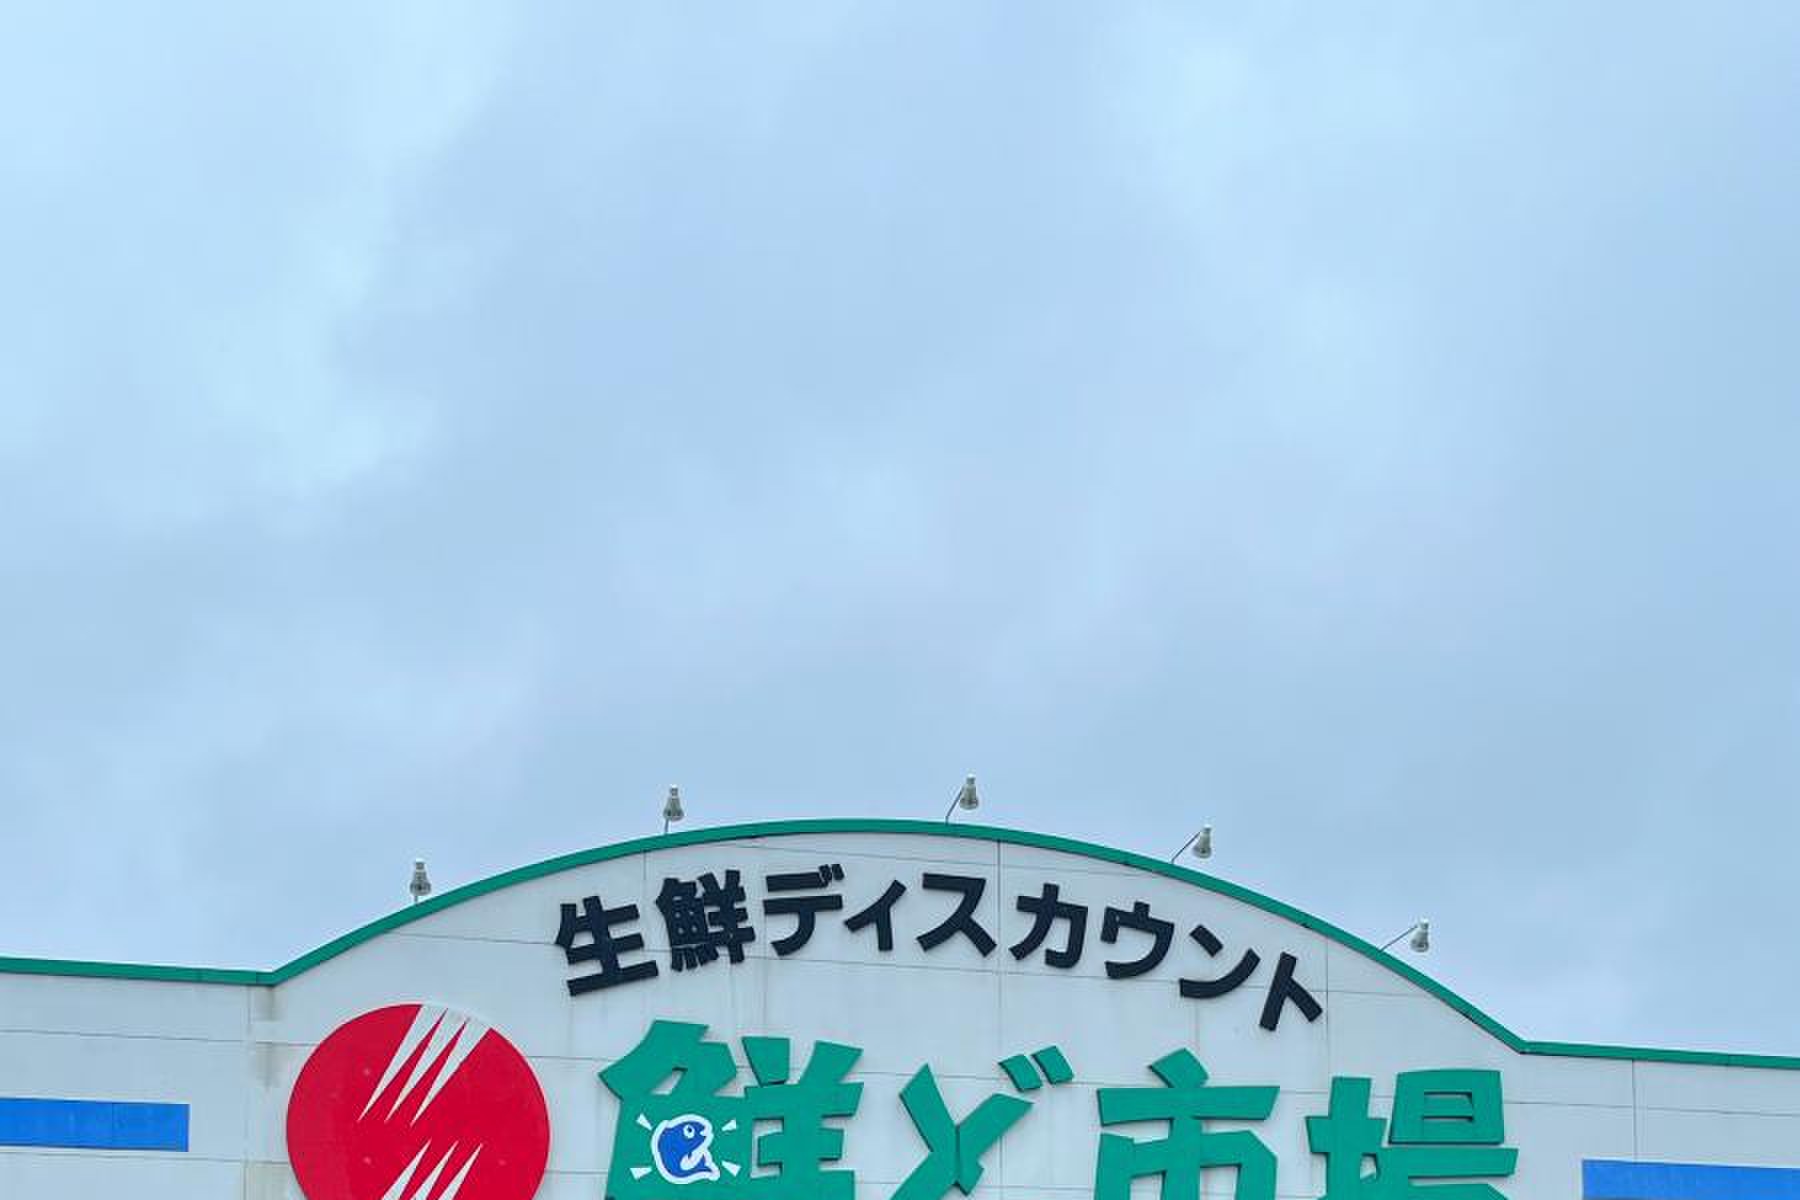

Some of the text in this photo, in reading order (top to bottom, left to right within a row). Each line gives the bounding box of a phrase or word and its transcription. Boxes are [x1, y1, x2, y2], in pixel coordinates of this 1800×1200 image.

[556, 864, 1322, 1031] 生鮮ディスカウント
